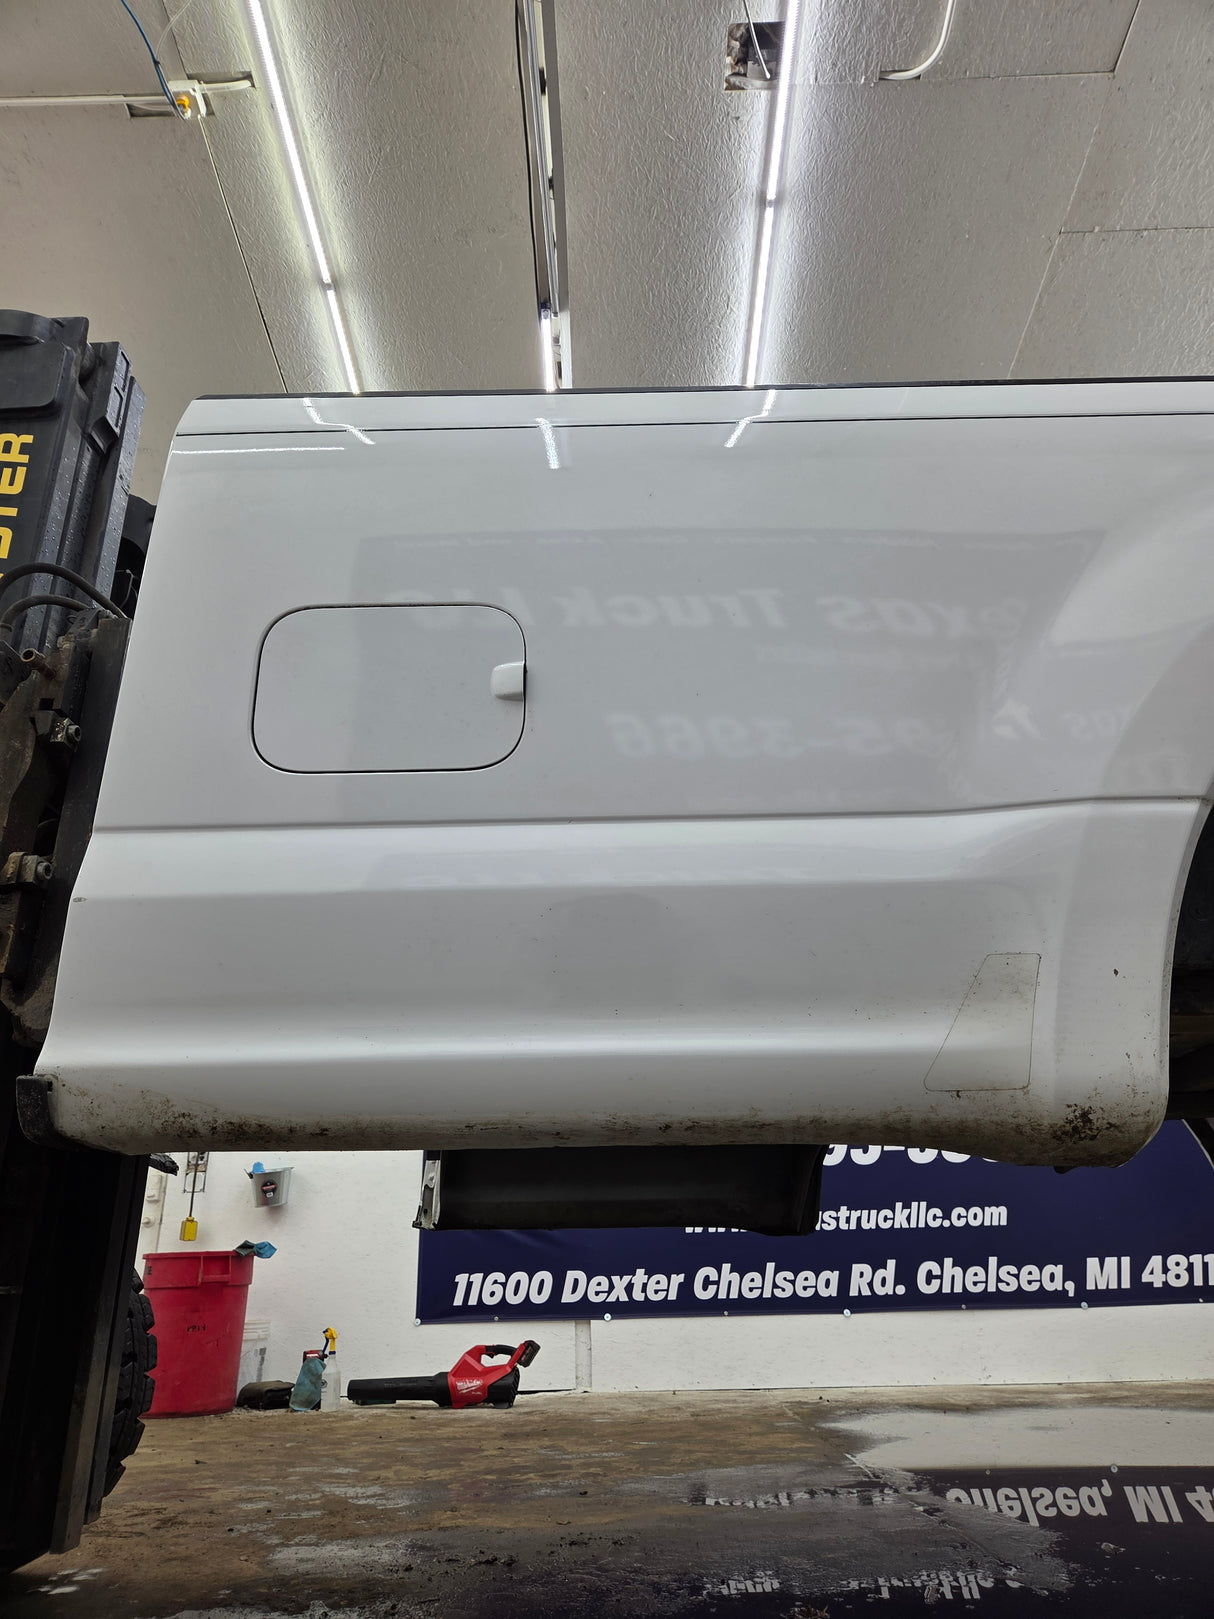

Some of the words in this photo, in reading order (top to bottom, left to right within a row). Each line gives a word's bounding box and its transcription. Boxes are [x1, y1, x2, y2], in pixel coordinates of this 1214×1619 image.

[453, 1270, 554, 1307] 11600
[560, 1268, 685, 1303] Dexter
[693, 1261, 840, 1300] Chelsea
[849, 1258, 906, 1297] Rd.
[916, 1256, 1075, 1297] Chelsea,
[1086, 1256, 1131, 1291] MI
